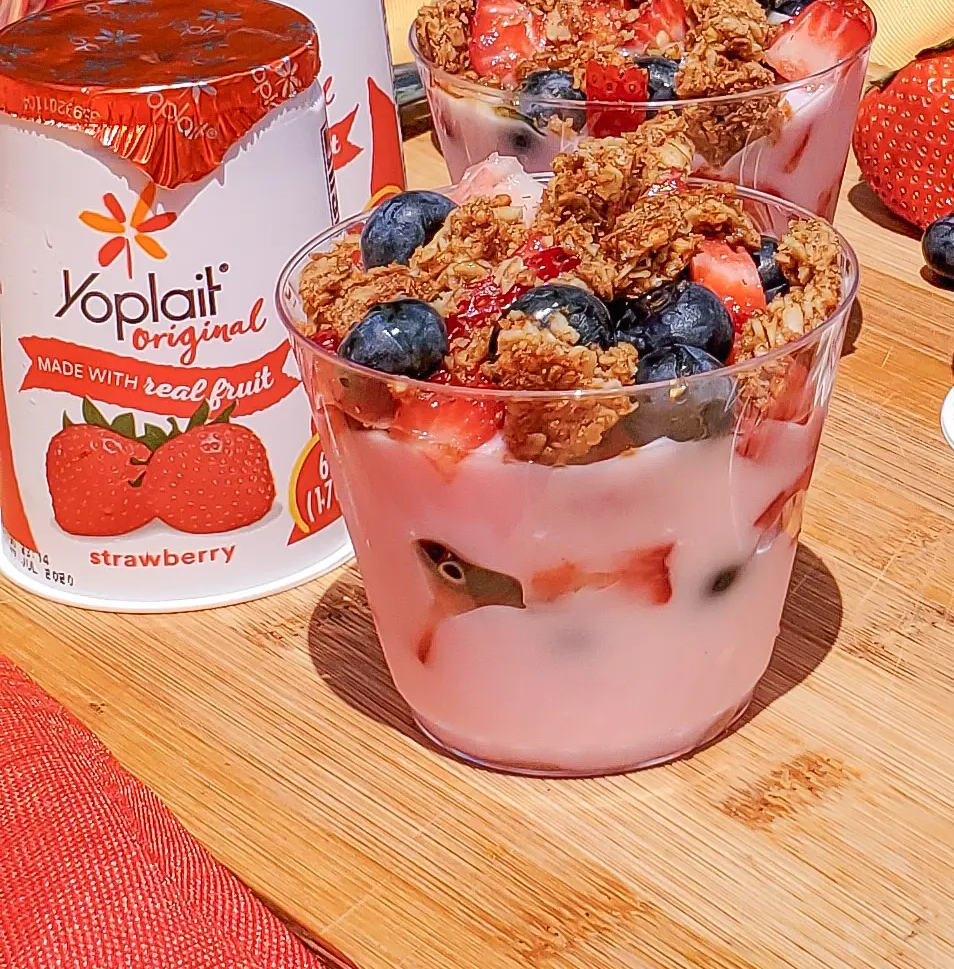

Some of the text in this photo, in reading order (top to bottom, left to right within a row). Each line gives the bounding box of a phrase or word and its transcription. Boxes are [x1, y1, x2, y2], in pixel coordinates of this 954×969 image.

[36, 355, 275, 412] MADE WITH real fruit
[319, 456, 330, 480] 6
[305, 481, 333, 523] (17
[89, 544, 236, 567] strawberry
[44, 568, 74, 587] 2020
